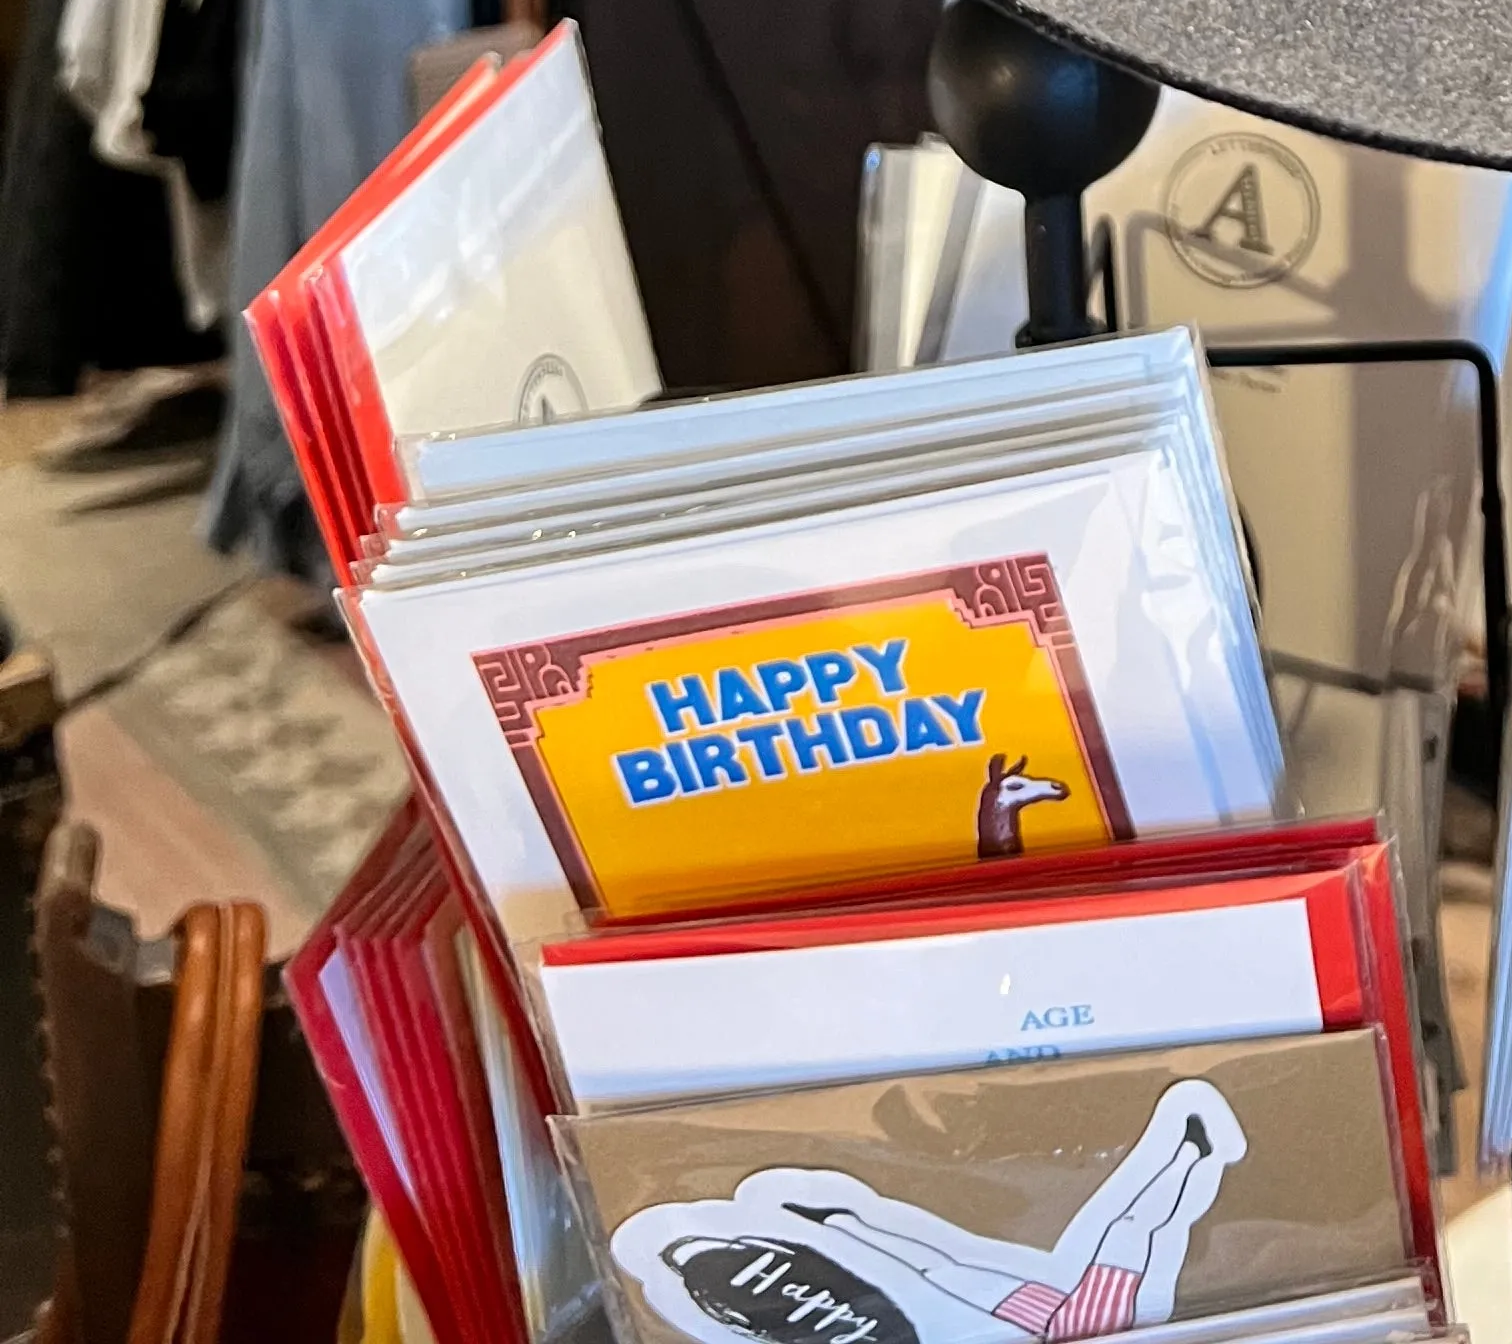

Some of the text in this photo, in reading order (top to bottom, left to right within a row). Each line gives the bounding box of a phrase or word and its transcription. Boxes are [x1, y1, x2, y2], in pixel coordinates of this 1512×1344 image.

[647, 637, 909, 737] HAPPY
[613, 688, 986, 807] BIRTHDAY
[1020, 1004, 1095, 1031] AGE
[729, 1251, 878, 1344] Happy
